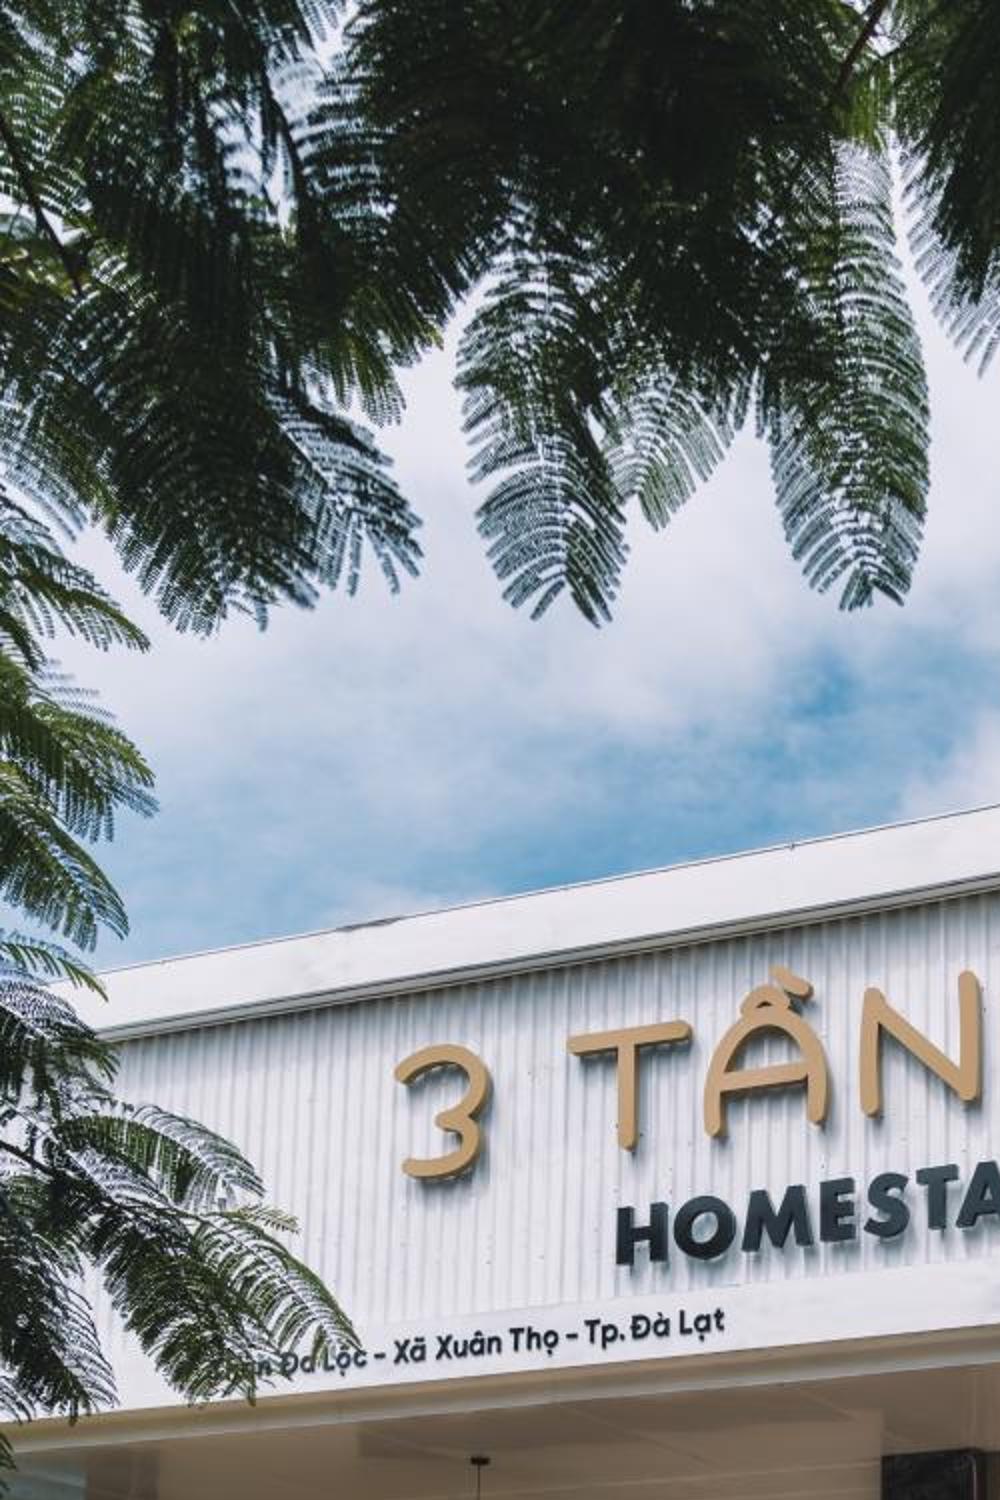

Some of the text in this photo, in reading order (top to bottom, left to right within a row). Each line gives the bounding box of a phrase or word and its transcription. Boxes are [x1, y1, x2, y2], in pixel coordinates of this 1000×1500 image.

[393, 1043, 491, 1181] 3
[393, 1335, 427, 1365] Xã
[435, 1329, 503, 1361] Xuân
[508, 1325, 560, 1357] Thọ
[679, 1307, 726, 1343] Lạt
